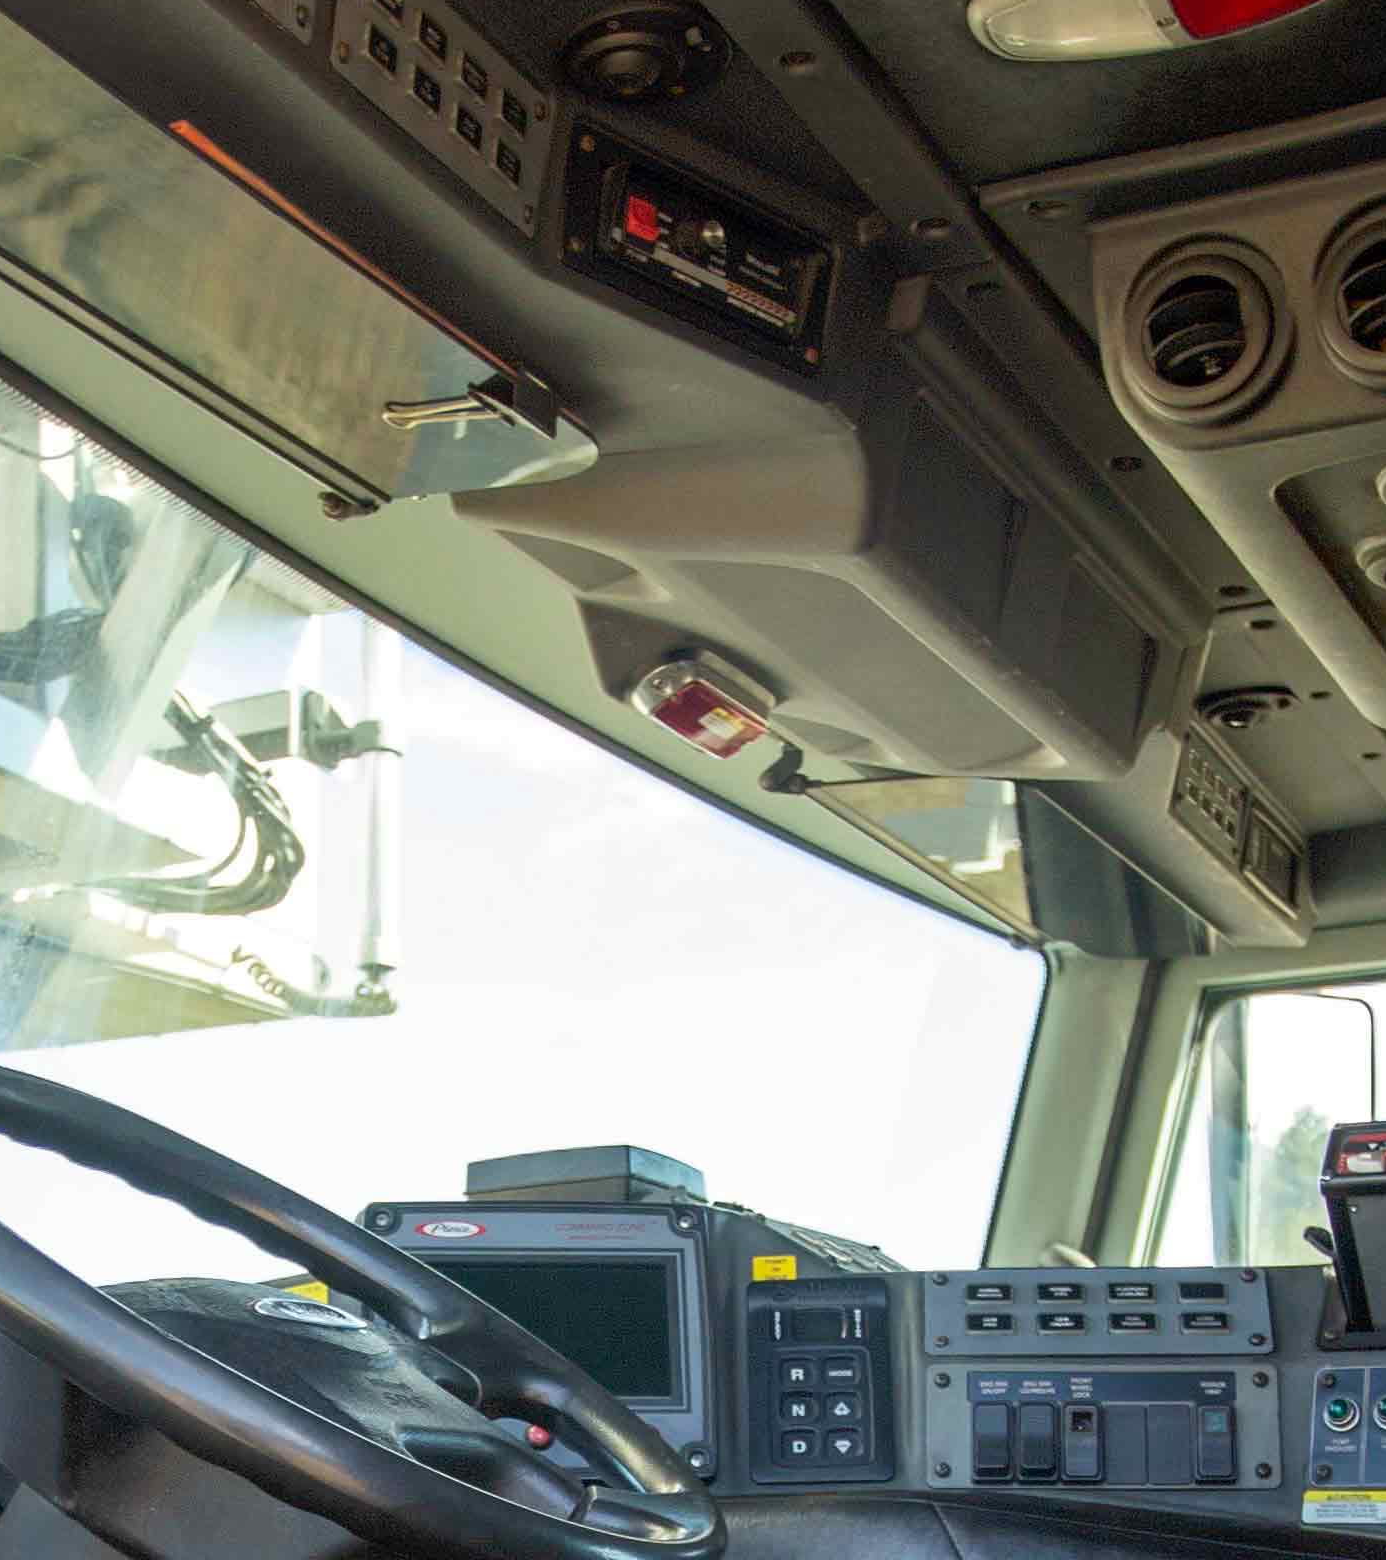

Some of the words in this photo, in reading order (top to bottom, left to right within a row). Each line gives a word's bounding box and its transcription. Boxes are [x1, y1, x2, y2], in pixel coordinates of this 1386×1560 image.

[790, 1368, 803, 1382] R
[791, 1404, 805, 1417] N
[792, 1440, 806, 1454] D
